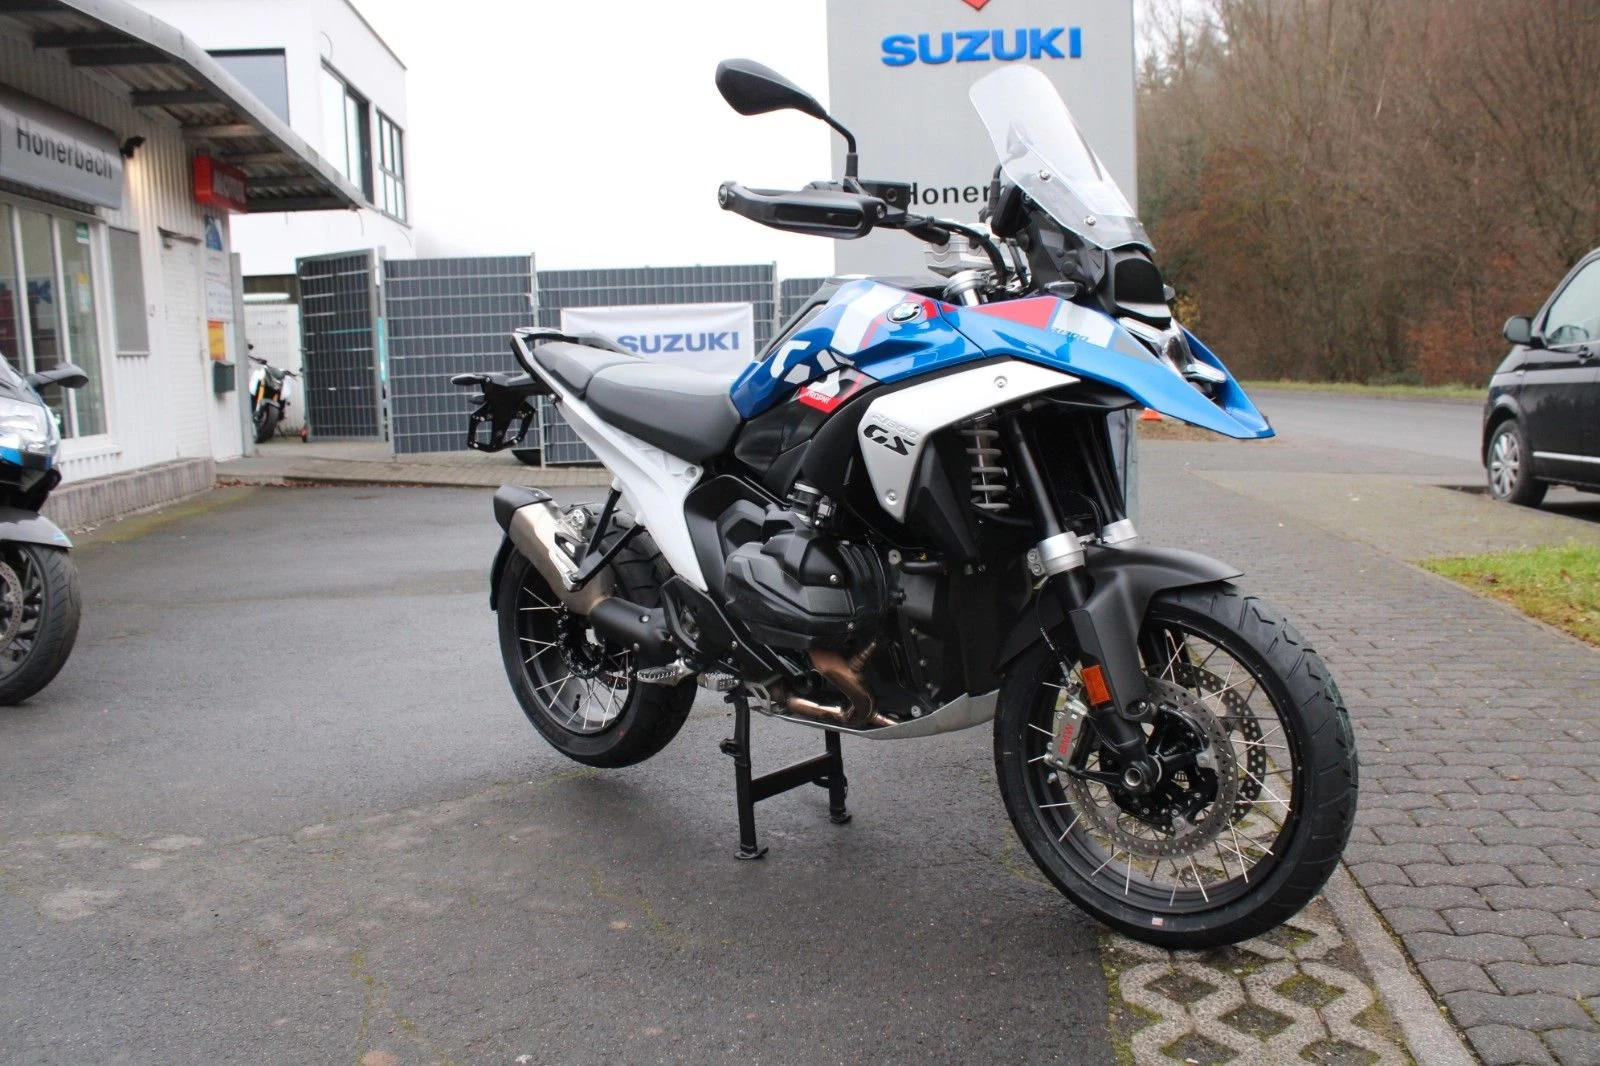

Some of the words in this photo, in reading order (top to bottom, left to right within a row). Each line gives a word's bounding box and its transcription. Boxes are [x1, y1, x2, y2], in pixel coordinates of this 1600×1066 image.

[880, 26, 1082, 67] SUZUKI
[16, 117, 113, 180] Honerbach
[909, 182, 1006, 205] Honer
[616, 331, 739, 354] SUZUKI
[863, 424, 917, 456] GS
